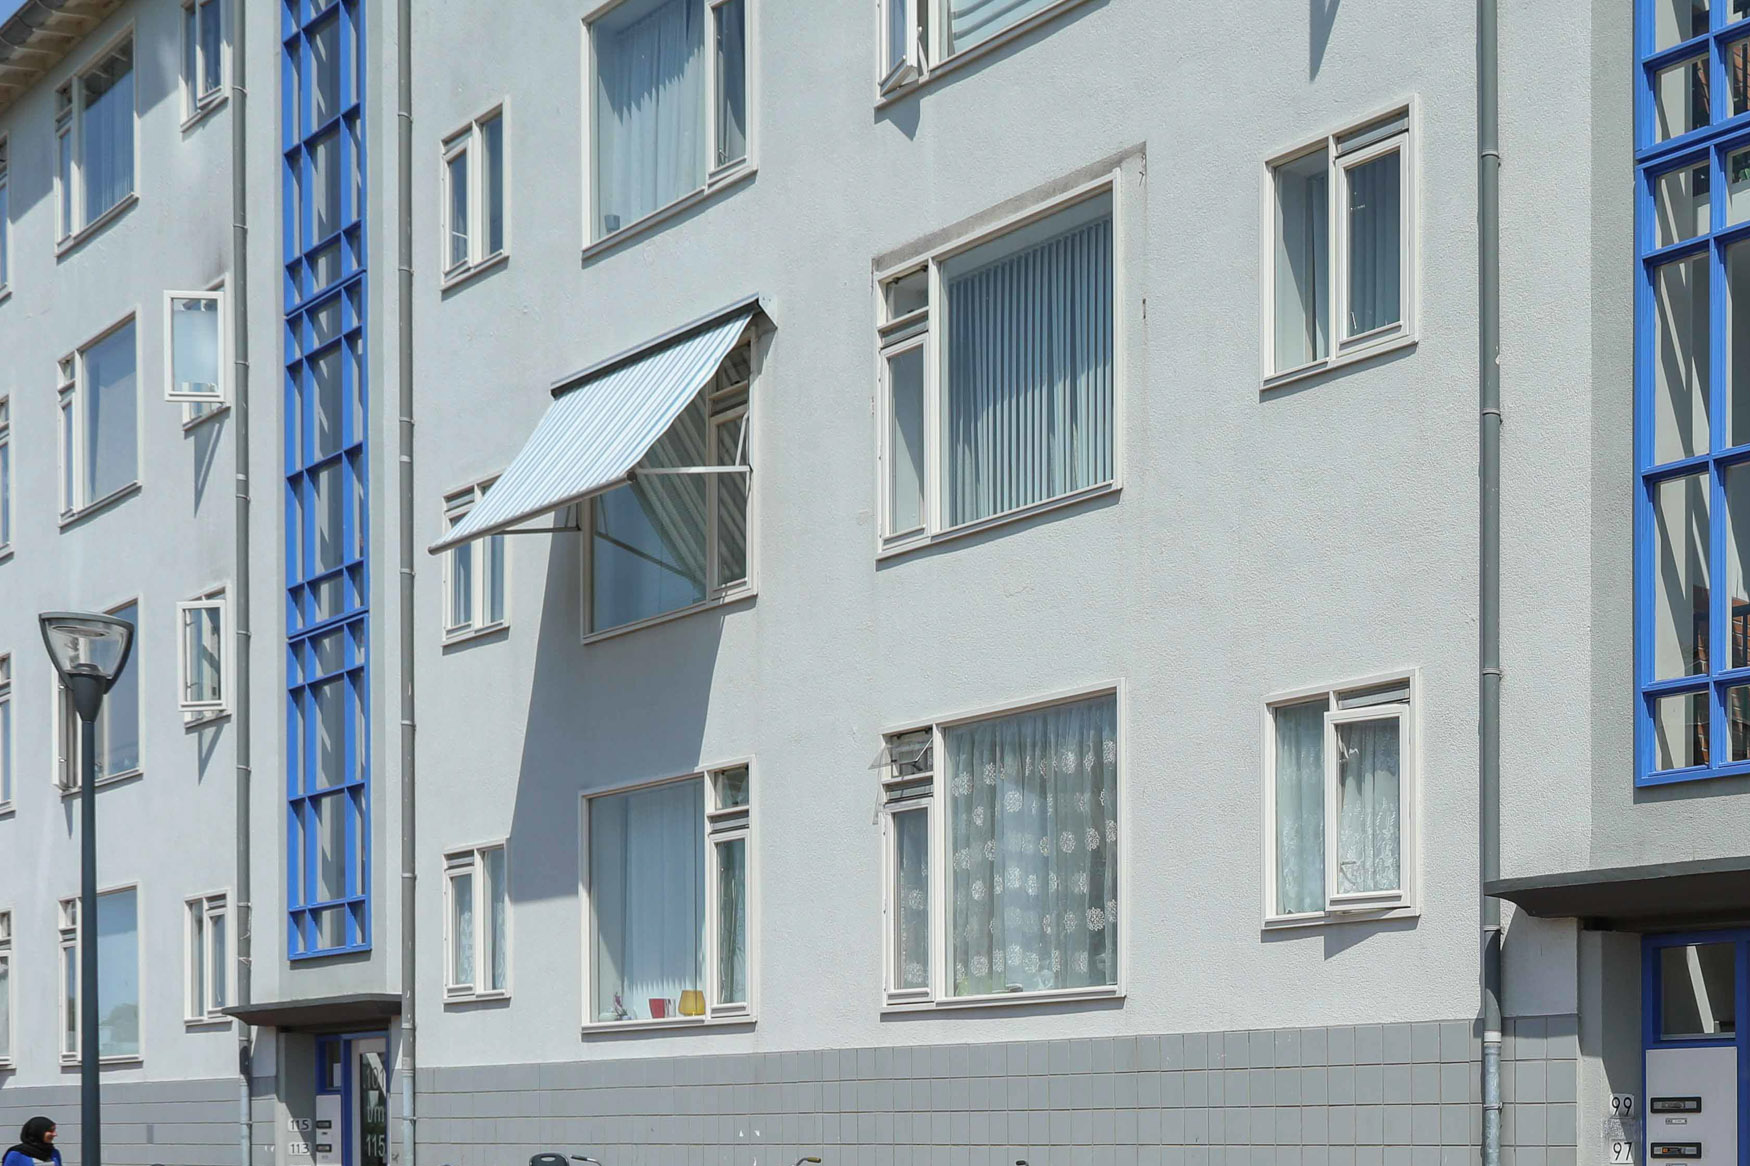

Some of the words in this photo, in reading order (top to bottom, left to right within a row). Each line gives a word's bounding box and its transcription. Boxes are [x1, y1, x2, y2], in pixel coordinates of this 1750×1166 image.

[1611, 1096, 1633, 1116] 99
[290, 1119, 309, 1131] 115
[290, 1143, 310, 1154] 113
[366, 1134, 386, 1157] 115
[1613, 1141, 1633, 1161] 97
